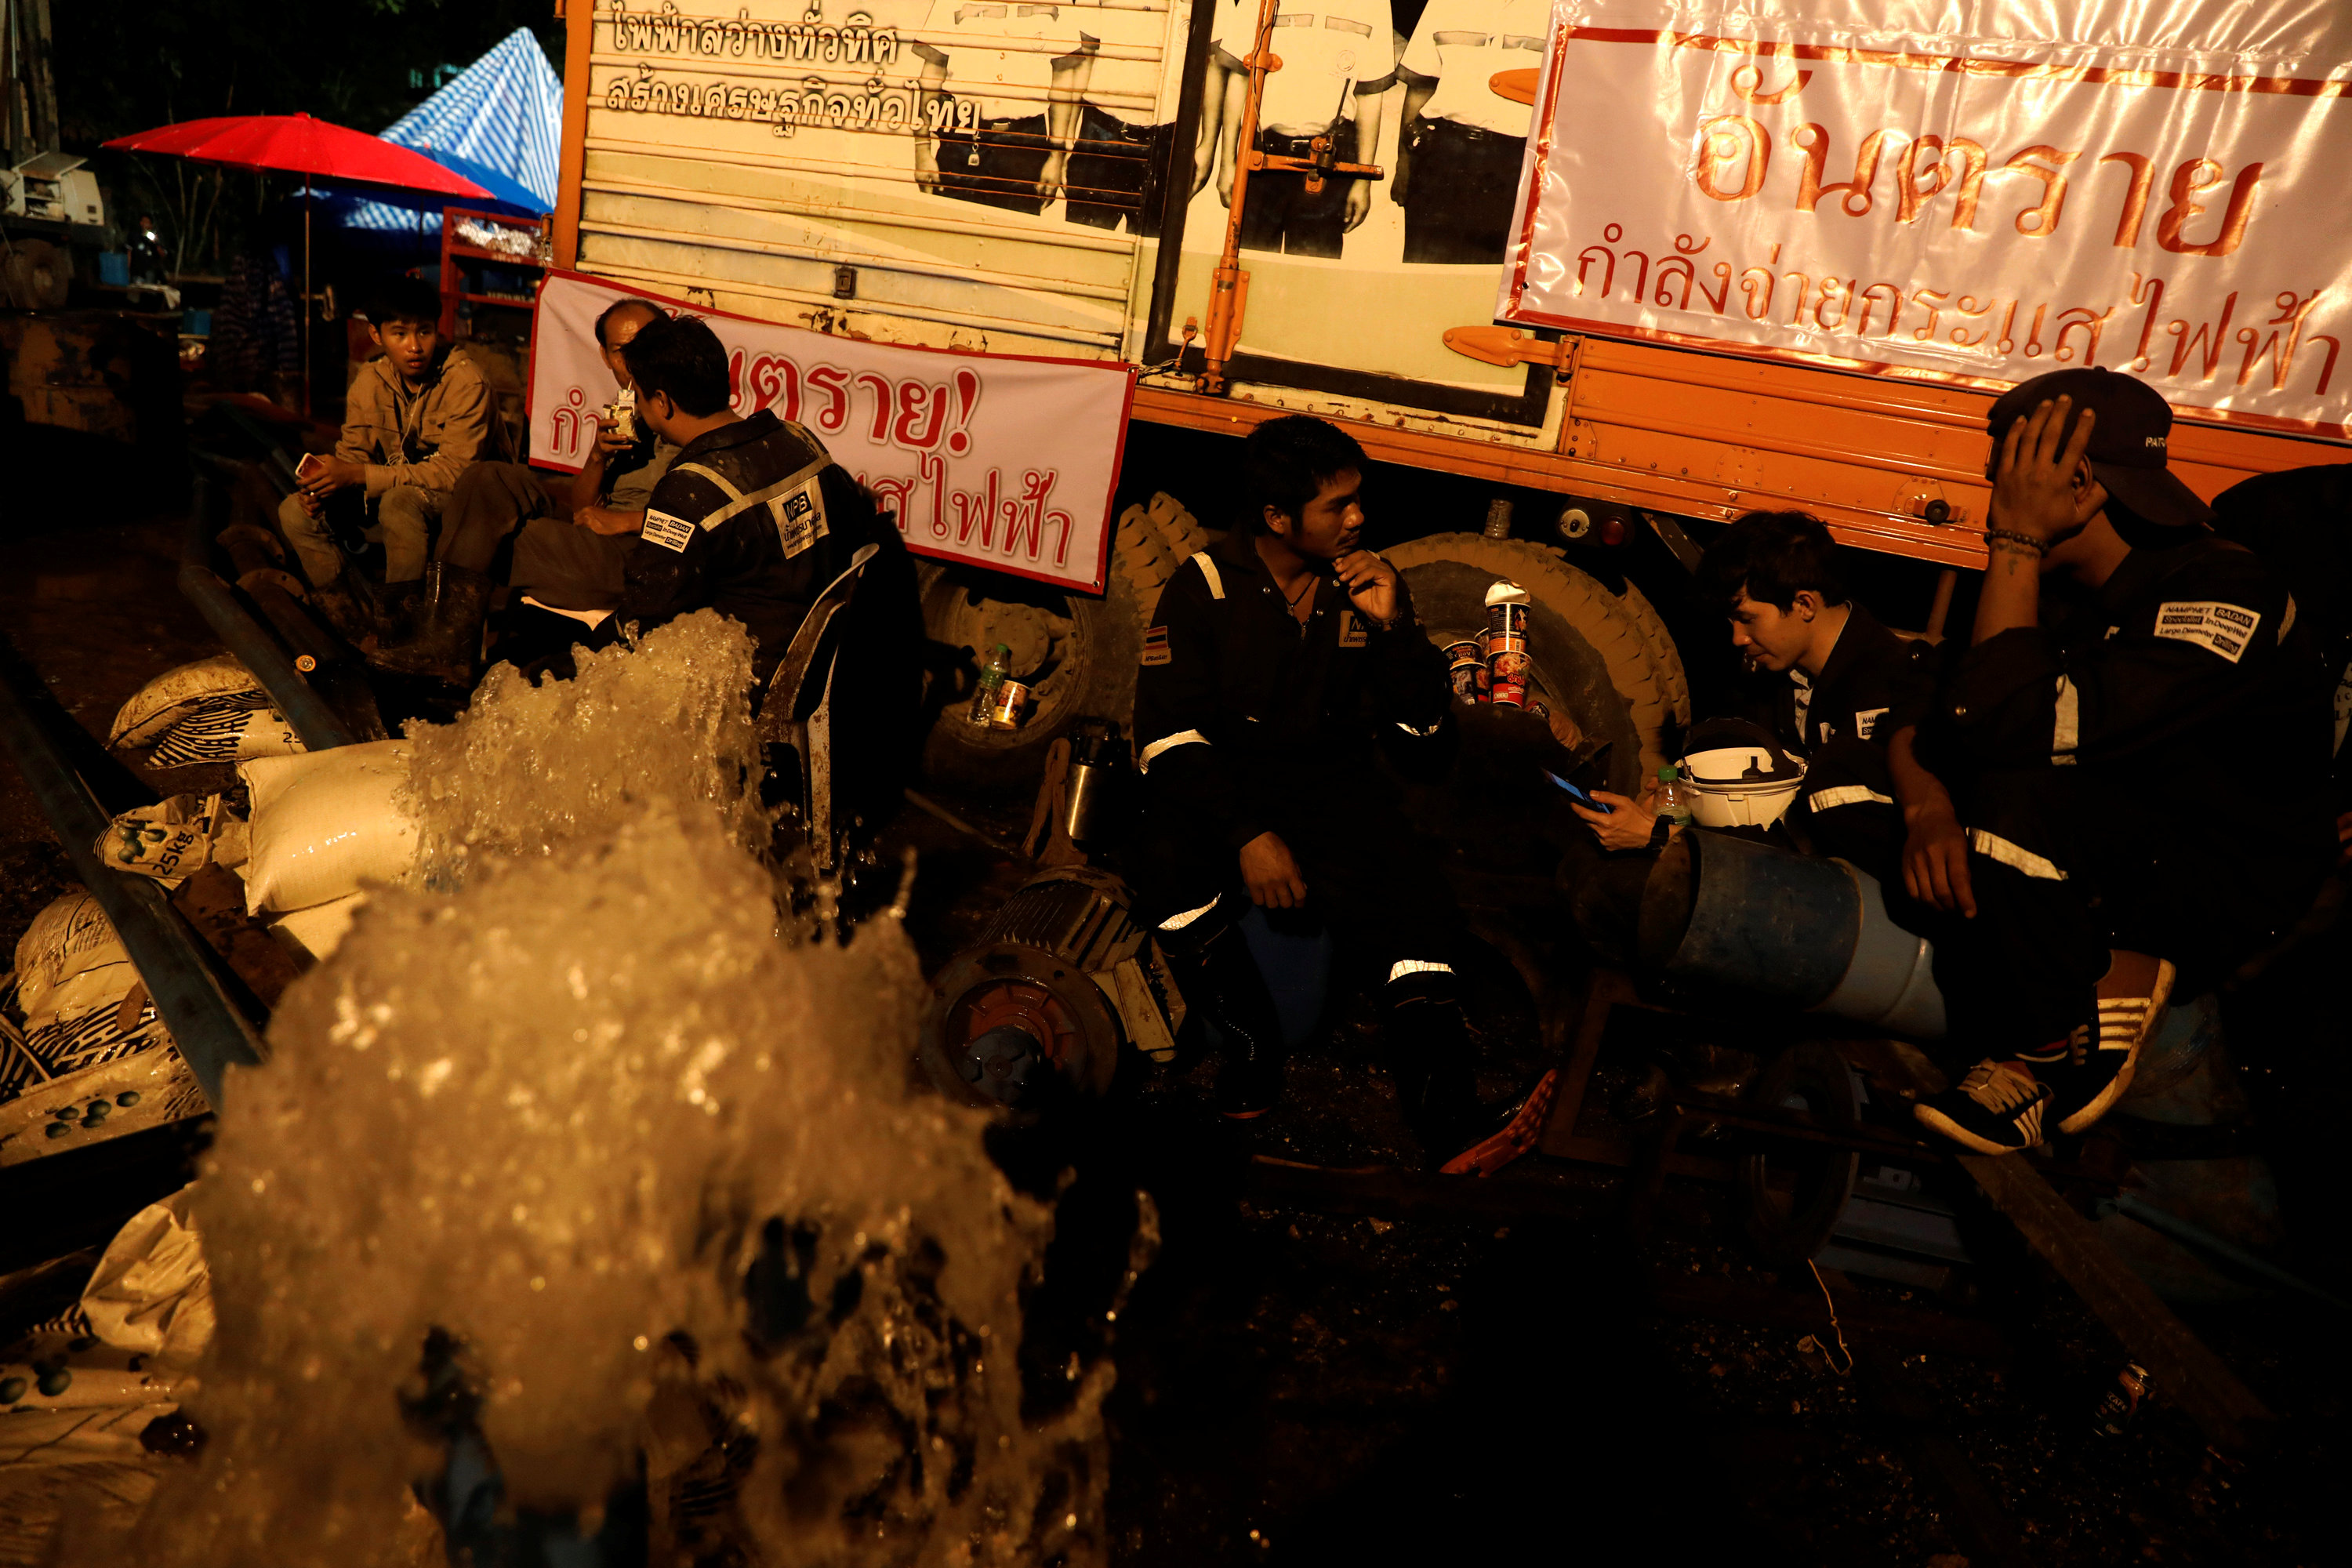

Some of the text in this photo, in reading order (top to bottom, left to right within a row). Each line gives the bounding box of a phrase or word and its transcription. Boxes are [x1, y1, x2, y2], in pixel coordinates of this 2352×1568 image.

[613, 0, 899, 64] ไฟฟ้าสว่างทั่วทิศ
[607, 64, 982, 137] สร้างเศรษฐกิจทั่วไทย
[1695, 64, 2264, 258] อันตราย
[669, 521, 691, 533] BADAN
[786, 495, 808, 521] NPB
[2216, 608, 2252, 627] BADAN
[152, 830, 194, 876] 25kg
